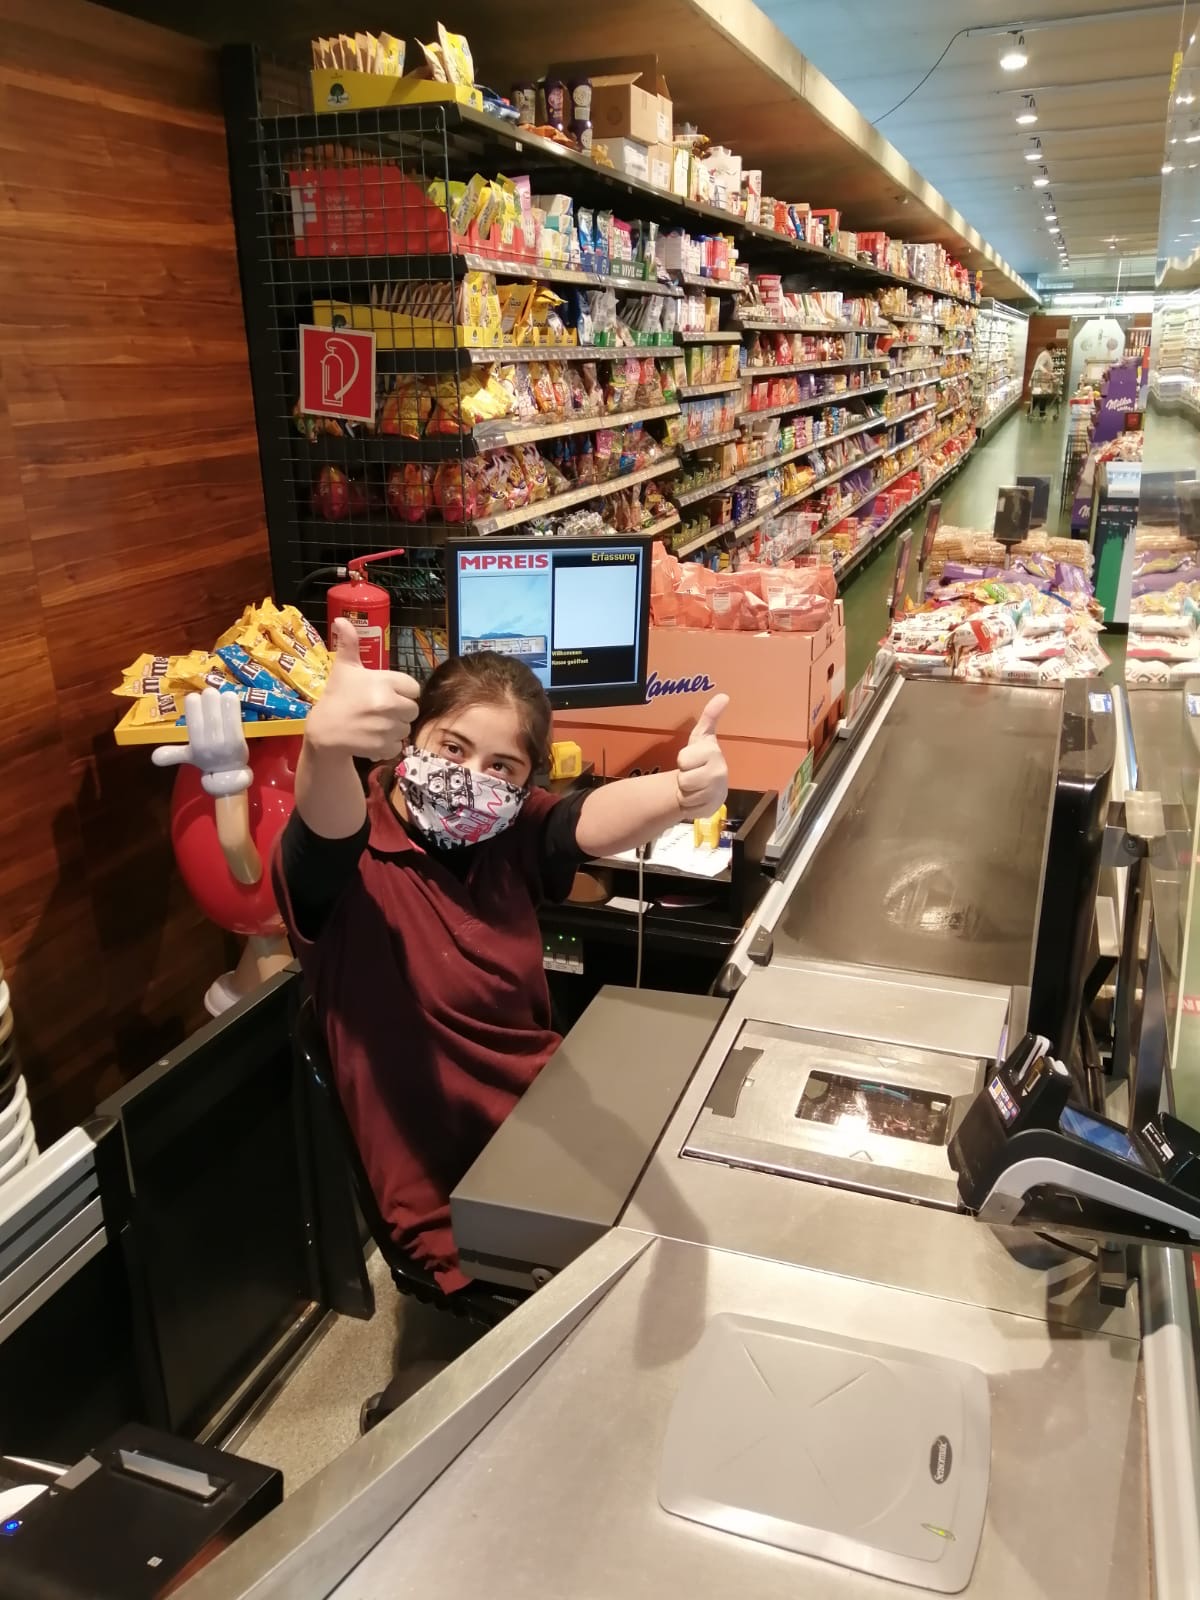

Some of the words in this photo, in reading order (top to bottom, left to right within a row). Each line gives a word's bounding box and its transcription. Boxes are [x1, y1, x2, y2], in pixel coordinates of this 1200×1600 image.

[460, 554, 549, 570] MPREIS
[591, 552, 635, 563] Erfassung
[646, 671, 715, 702] anner
